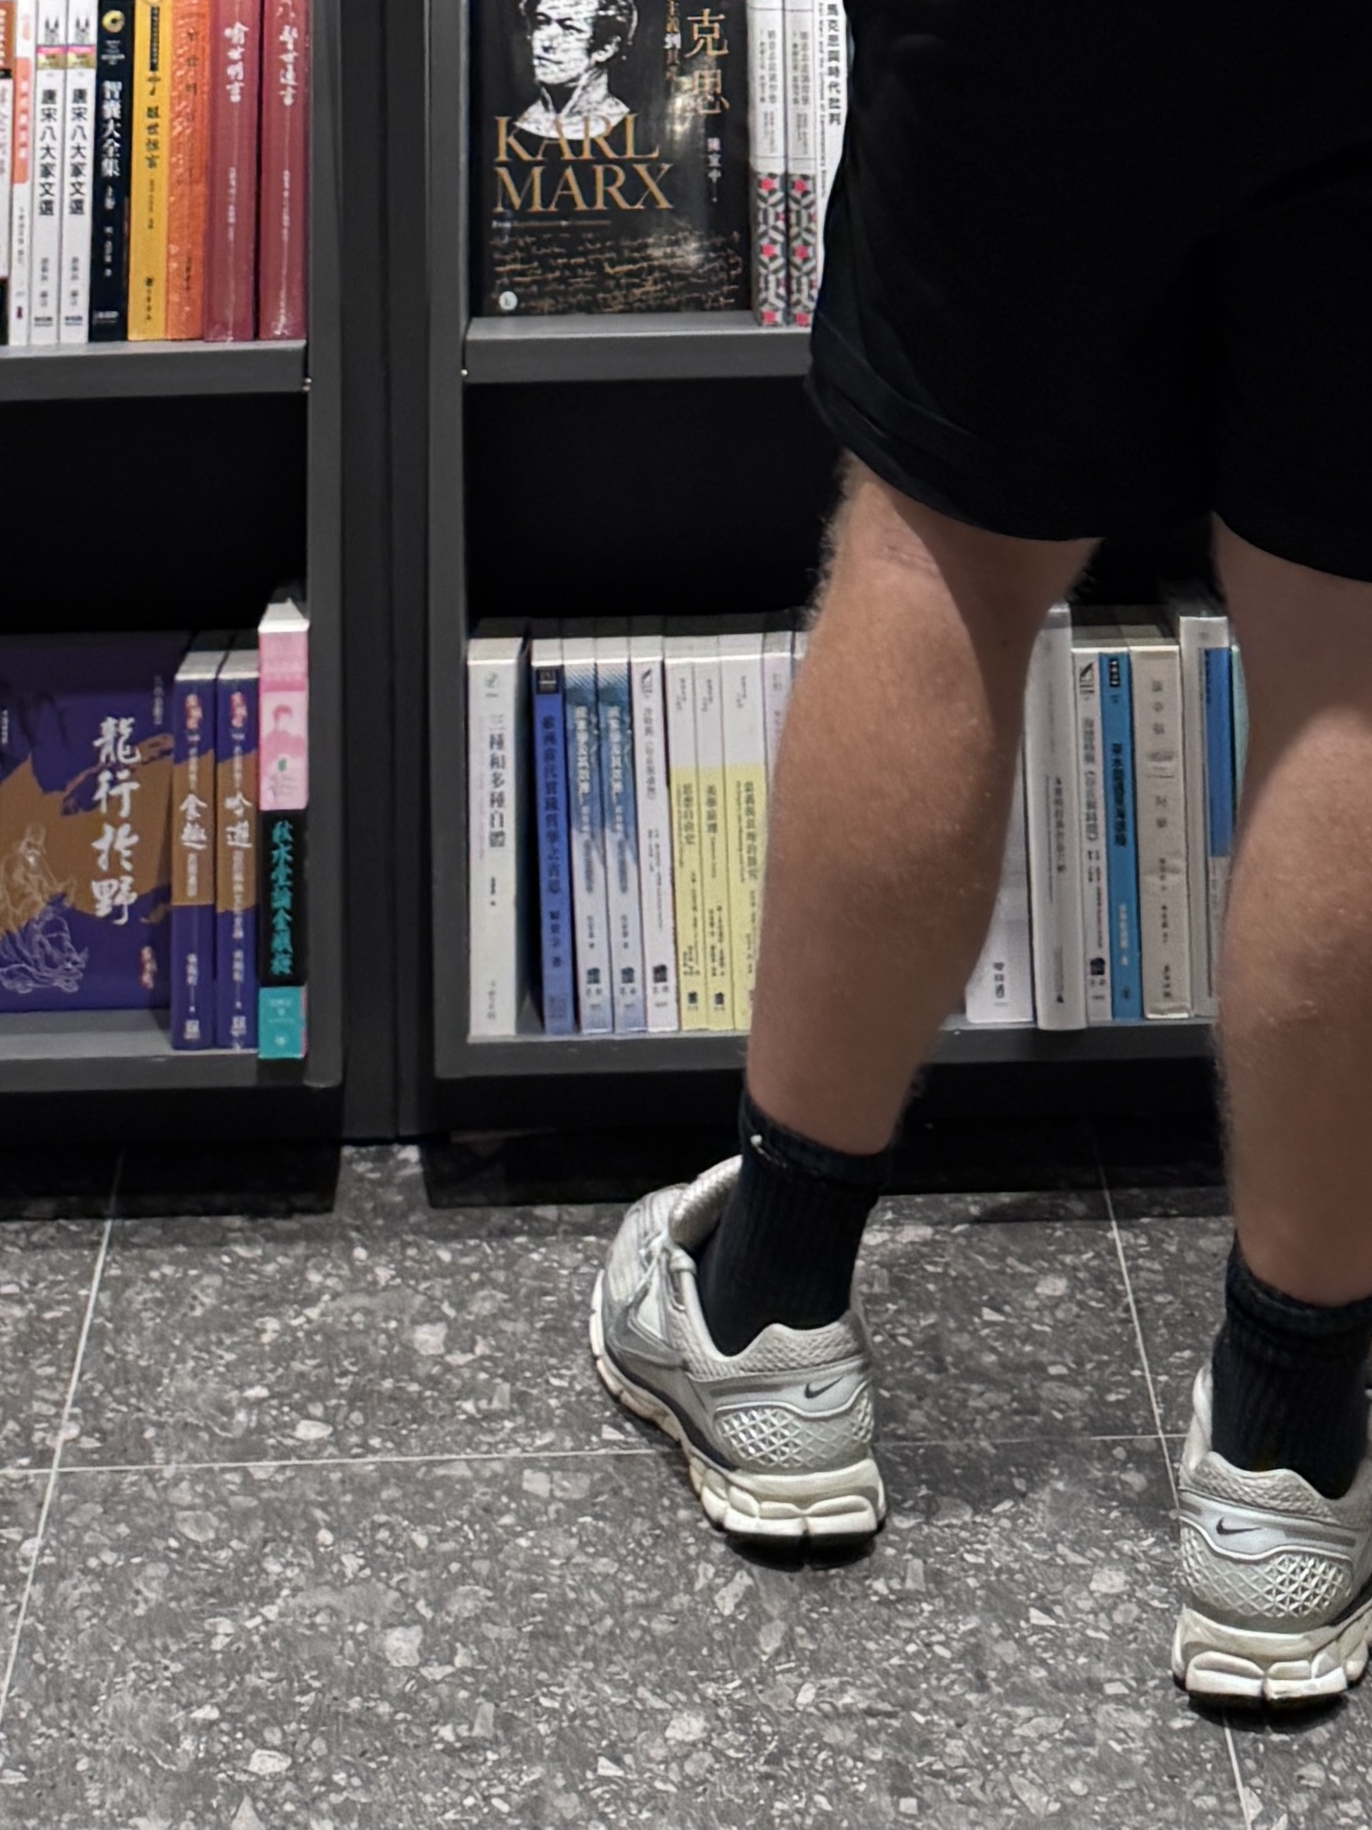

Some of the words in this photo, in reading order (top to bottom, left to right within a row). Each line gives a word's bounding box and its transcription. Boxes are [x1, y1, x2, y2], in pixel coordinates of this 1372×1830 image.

[39, 88, 58, 216] 唐宋八大家文選
[68, 88, 88, 216] 唐宋八大家文選
[494, 113, 660, 163] KARL
[492, 163, 675, 214] MARX
